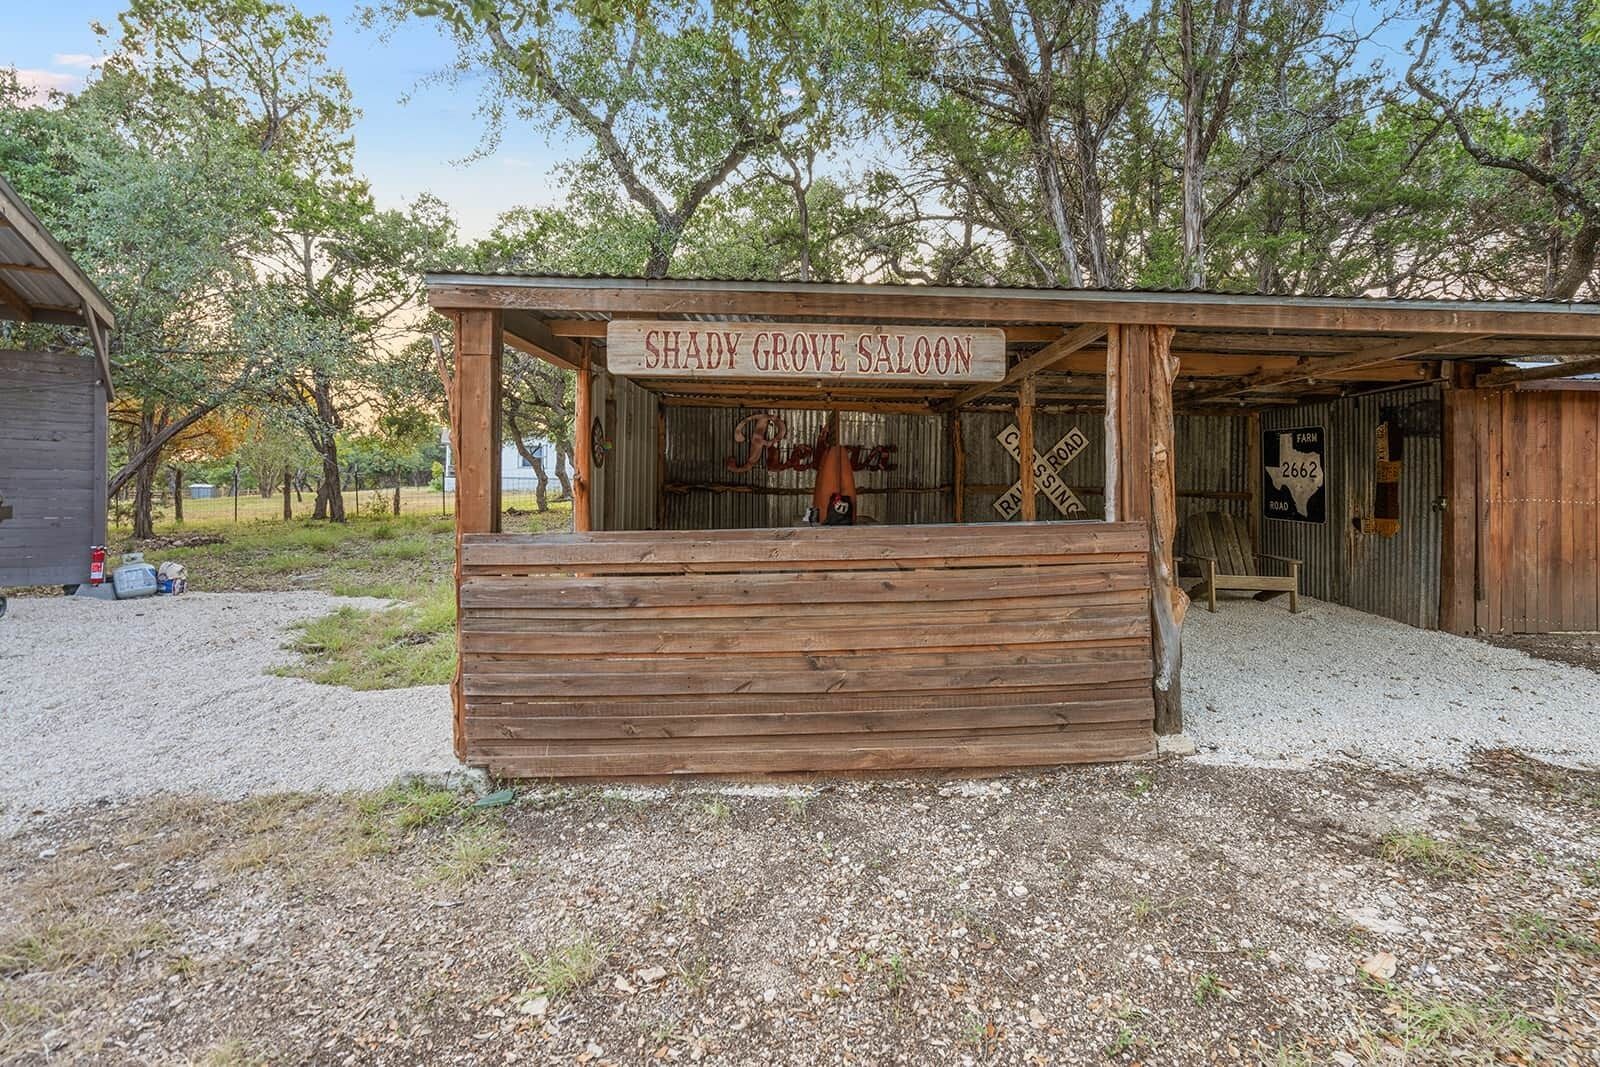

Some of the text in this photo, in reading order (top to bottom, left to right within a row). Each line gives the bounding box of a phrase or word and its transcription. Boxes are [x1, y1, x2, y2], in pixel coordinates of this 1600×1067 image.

[645, 330, 973, 375] SHADY GROVE SALOON
[1296, 432, 1318, 443] FARM
[1047, 433, 1084, 473] ROAD
[1282, 461, 1318, 478] 2662
[1269, 501, 1289, 511] ROAD
